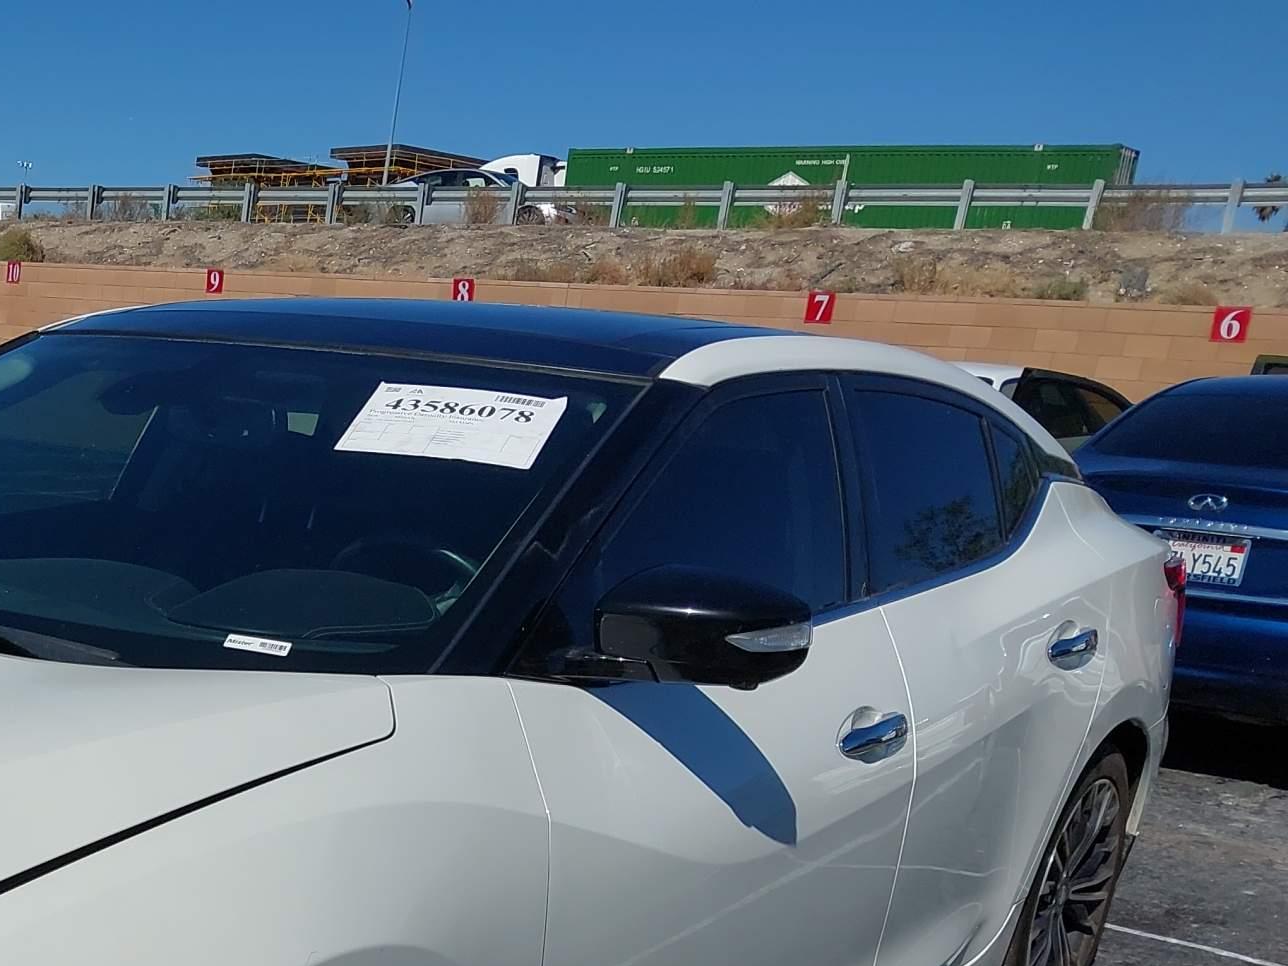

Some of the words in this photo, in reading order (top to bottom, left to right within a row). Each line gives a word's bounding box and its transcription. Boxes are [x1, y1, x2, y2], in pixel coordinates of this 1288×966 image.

[9, 265, 19, 282] 10
[210, 271, 219, 291] 9
[457, 281, 470, 301] 8
[814, 295, 829, 320] 7
[1220, 309, 1244, 339] 6
[385, 398, 534, 423] 43586078
